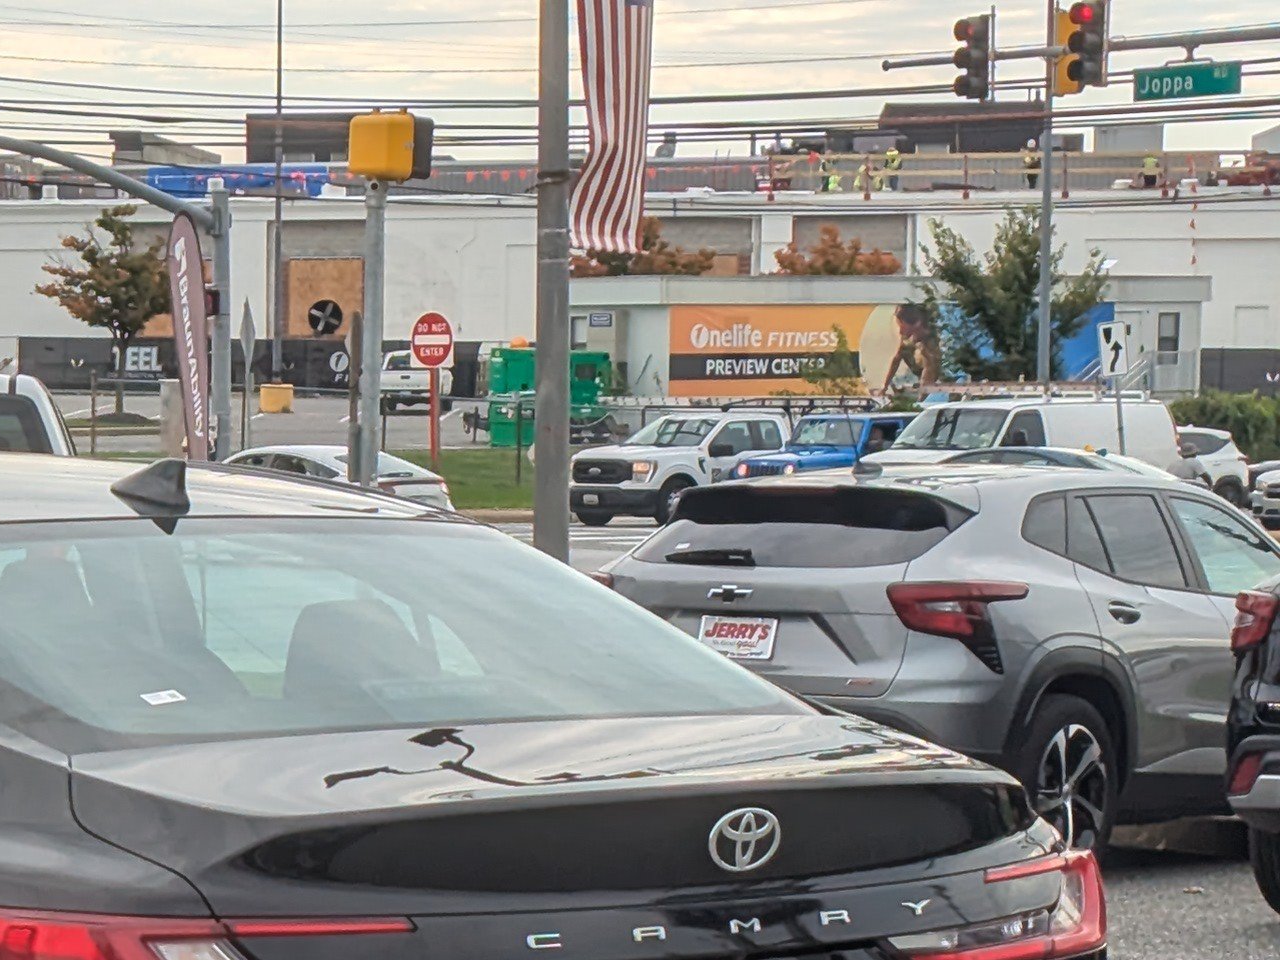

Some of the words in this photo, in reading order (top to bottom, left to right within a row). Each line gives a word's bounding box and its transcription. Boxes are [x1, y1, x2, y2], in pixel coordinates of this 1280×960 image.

[1140, 76, 1193, 96] Joppa
[417, 322, 429, 332] DO
[431, 322, 447, 332] NOT
[767, 331, 838, 348] FITNESS
[420, 346, 444, 357] ENTER
[705, 358, 769, 376] PREVIEW
[704, 621, 772, 640] JERRY'S
[526, 898, 931, 950] CAMRY
